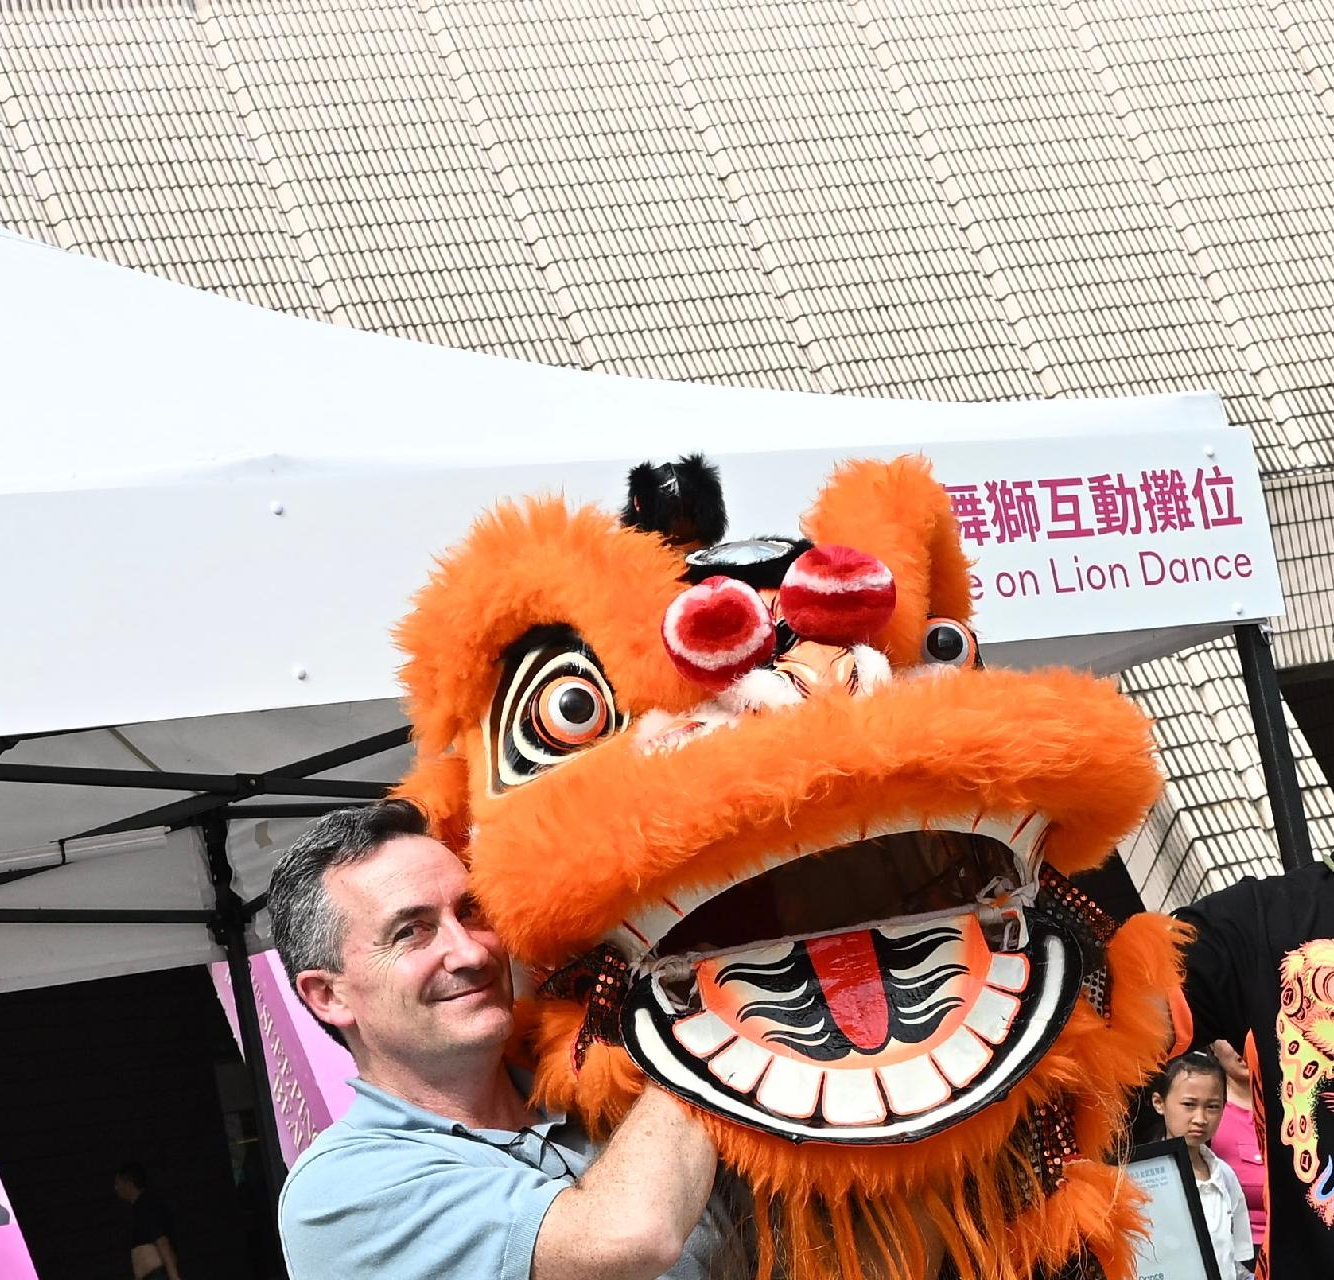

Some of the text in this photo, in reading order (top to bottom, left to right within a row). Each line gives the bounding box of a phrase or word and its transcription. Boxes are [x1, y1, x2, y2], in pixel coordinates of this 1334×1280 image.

[996, 568, 1040, 598] on
[1050, 555, 1130, 595] Lion
[1139, 550, 1253, 587] Dance
